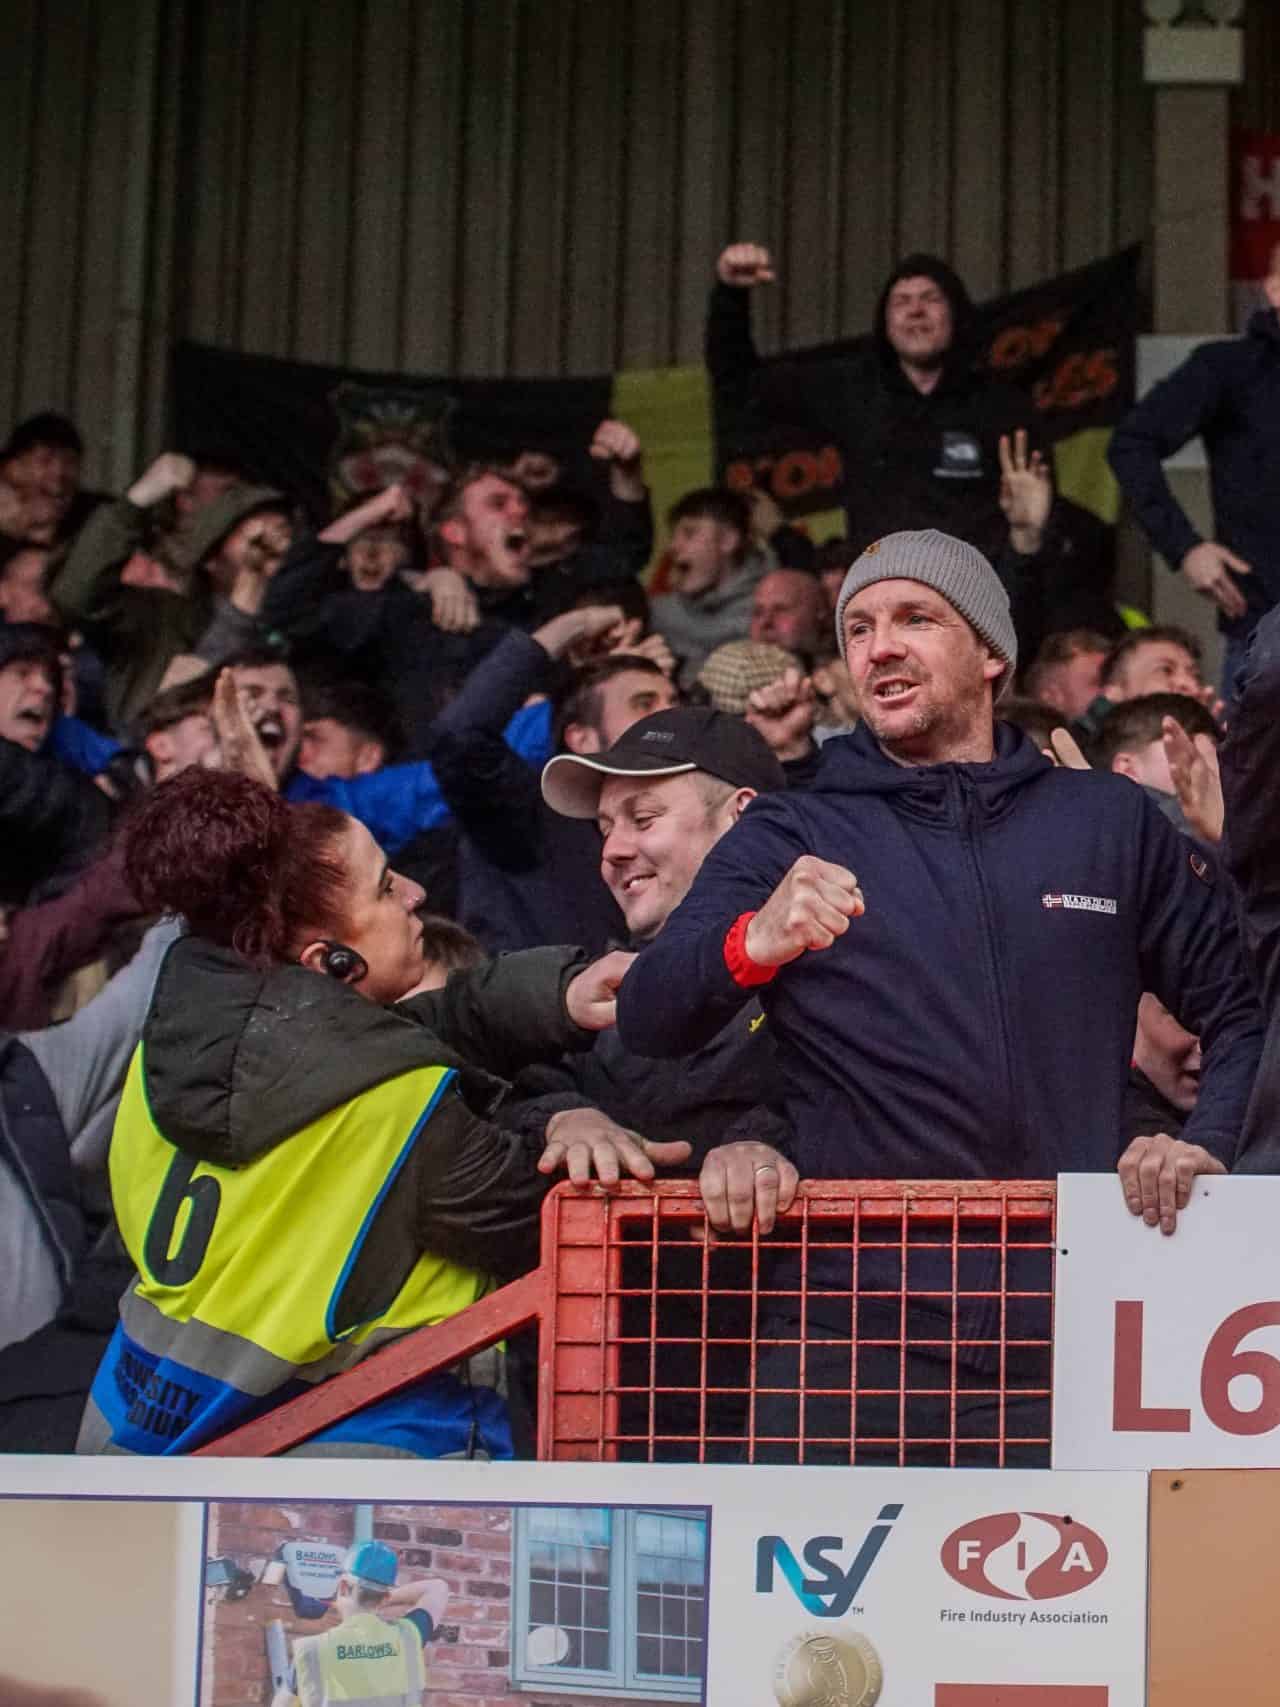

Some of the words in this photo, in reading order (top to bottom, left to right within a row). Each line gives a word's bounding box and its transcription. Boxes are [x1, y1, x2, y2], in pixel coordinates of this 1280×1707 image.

[142, 1147, 222, 1288] 6
[940, 1609, 966, 1622] Fire
[970, 1610, 1026, 1626] Industry
[1030, 1610, 1108, 1624] Association
